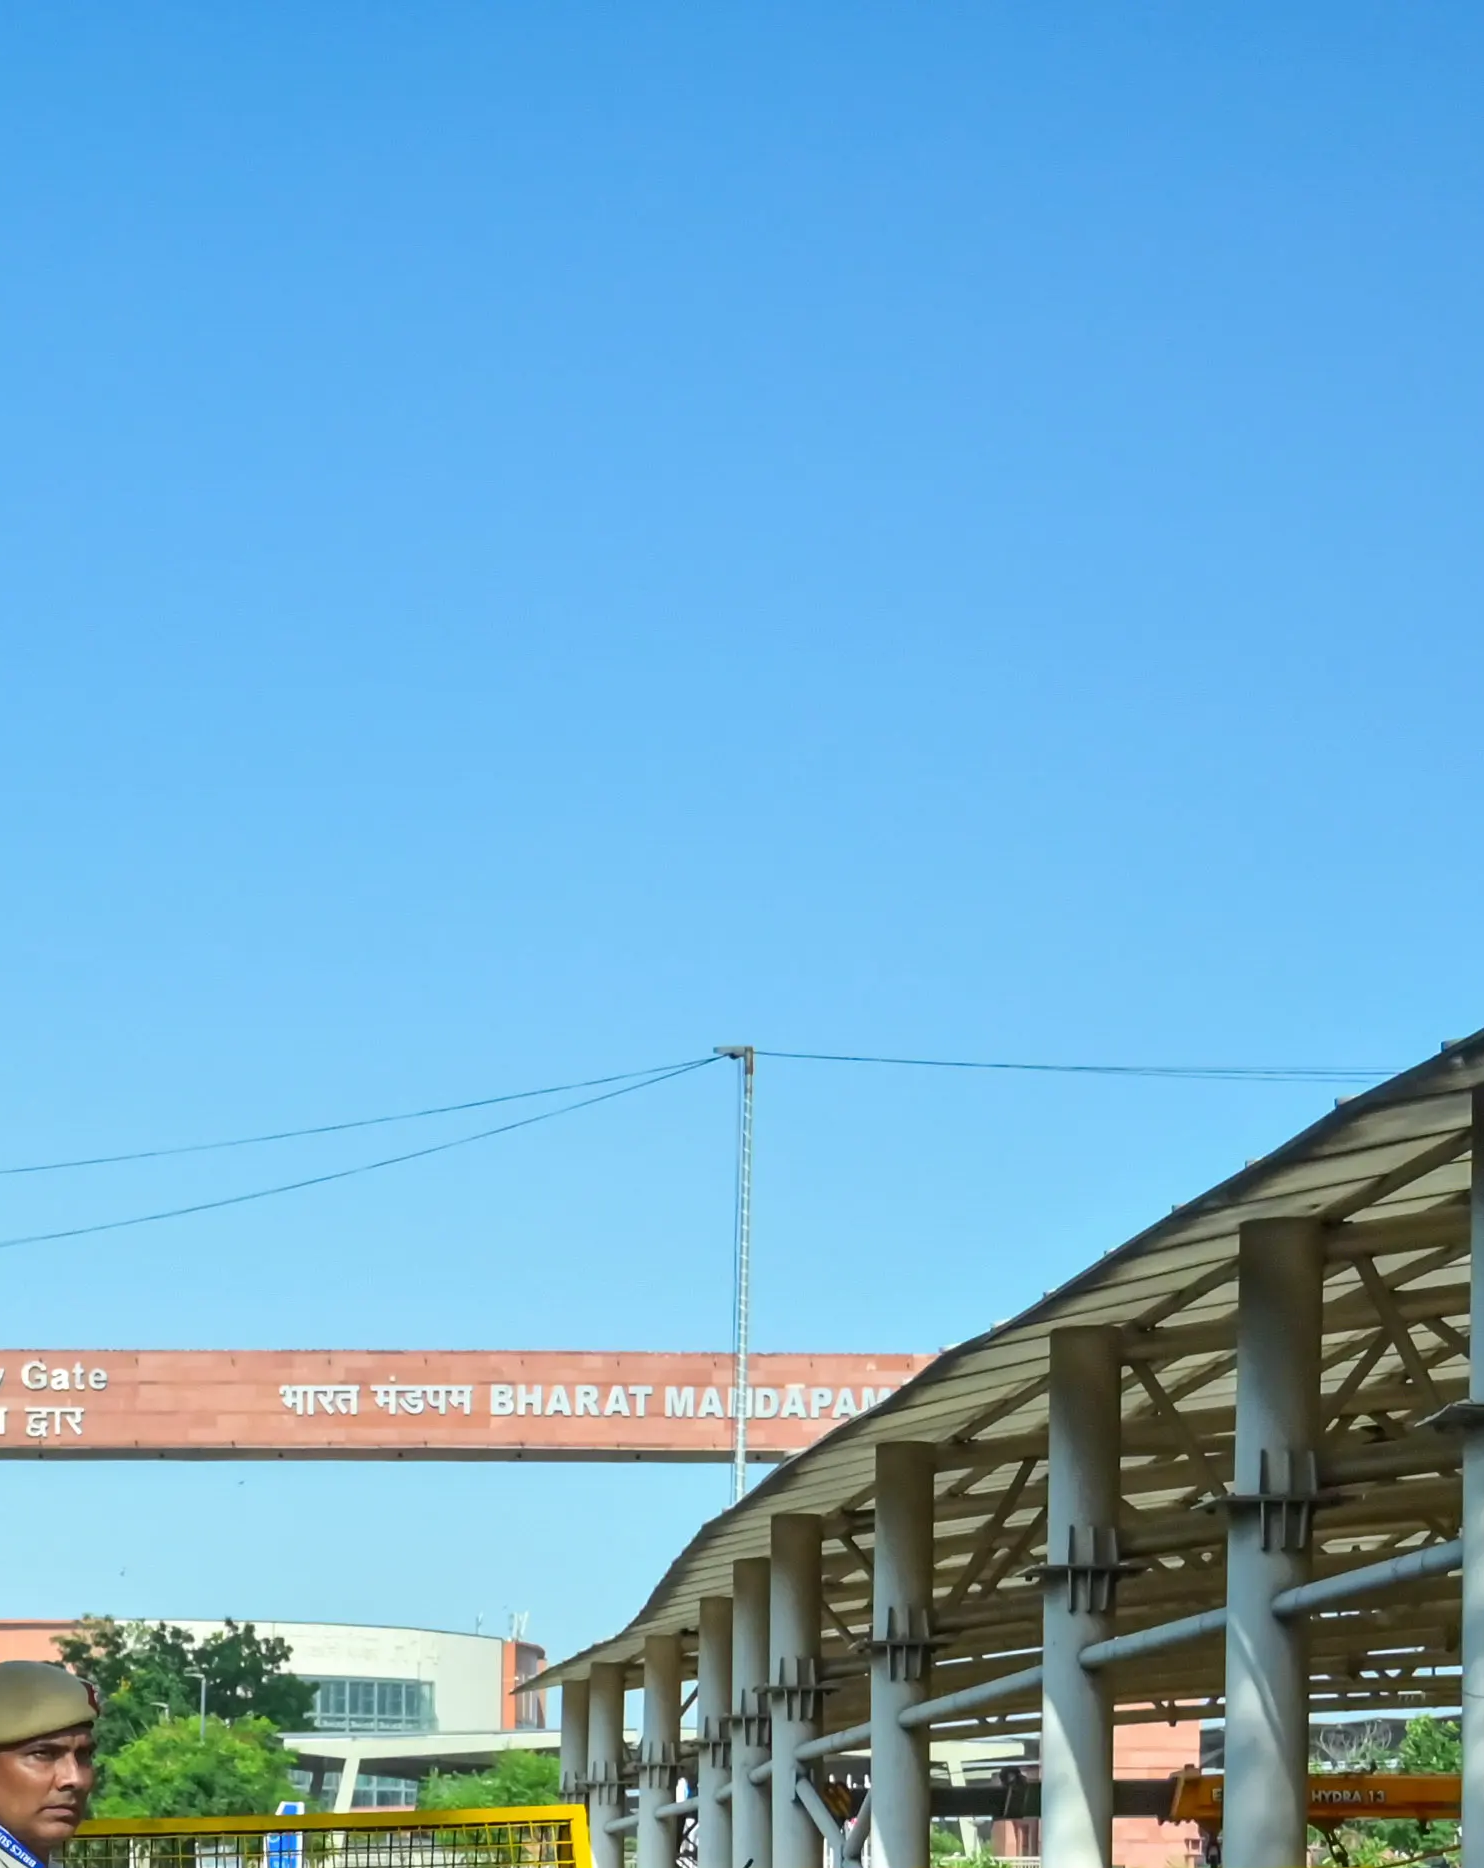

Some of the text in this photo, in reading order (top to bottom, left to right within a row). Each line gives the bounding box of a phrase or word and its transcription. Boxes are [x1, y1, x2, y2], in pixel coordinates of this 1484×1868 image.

[21, 1360, 108, 1391] Gate
[279, 1376, 472, 1416] भारत मंडपम
[489, 1385, 654, 1417] BHARAT
[25, 1406, 85, 1437] द्वार
[1311, 1790, 1386, 1803] HYDRA 13
[9, 1844, 37, 1868] BRICS
